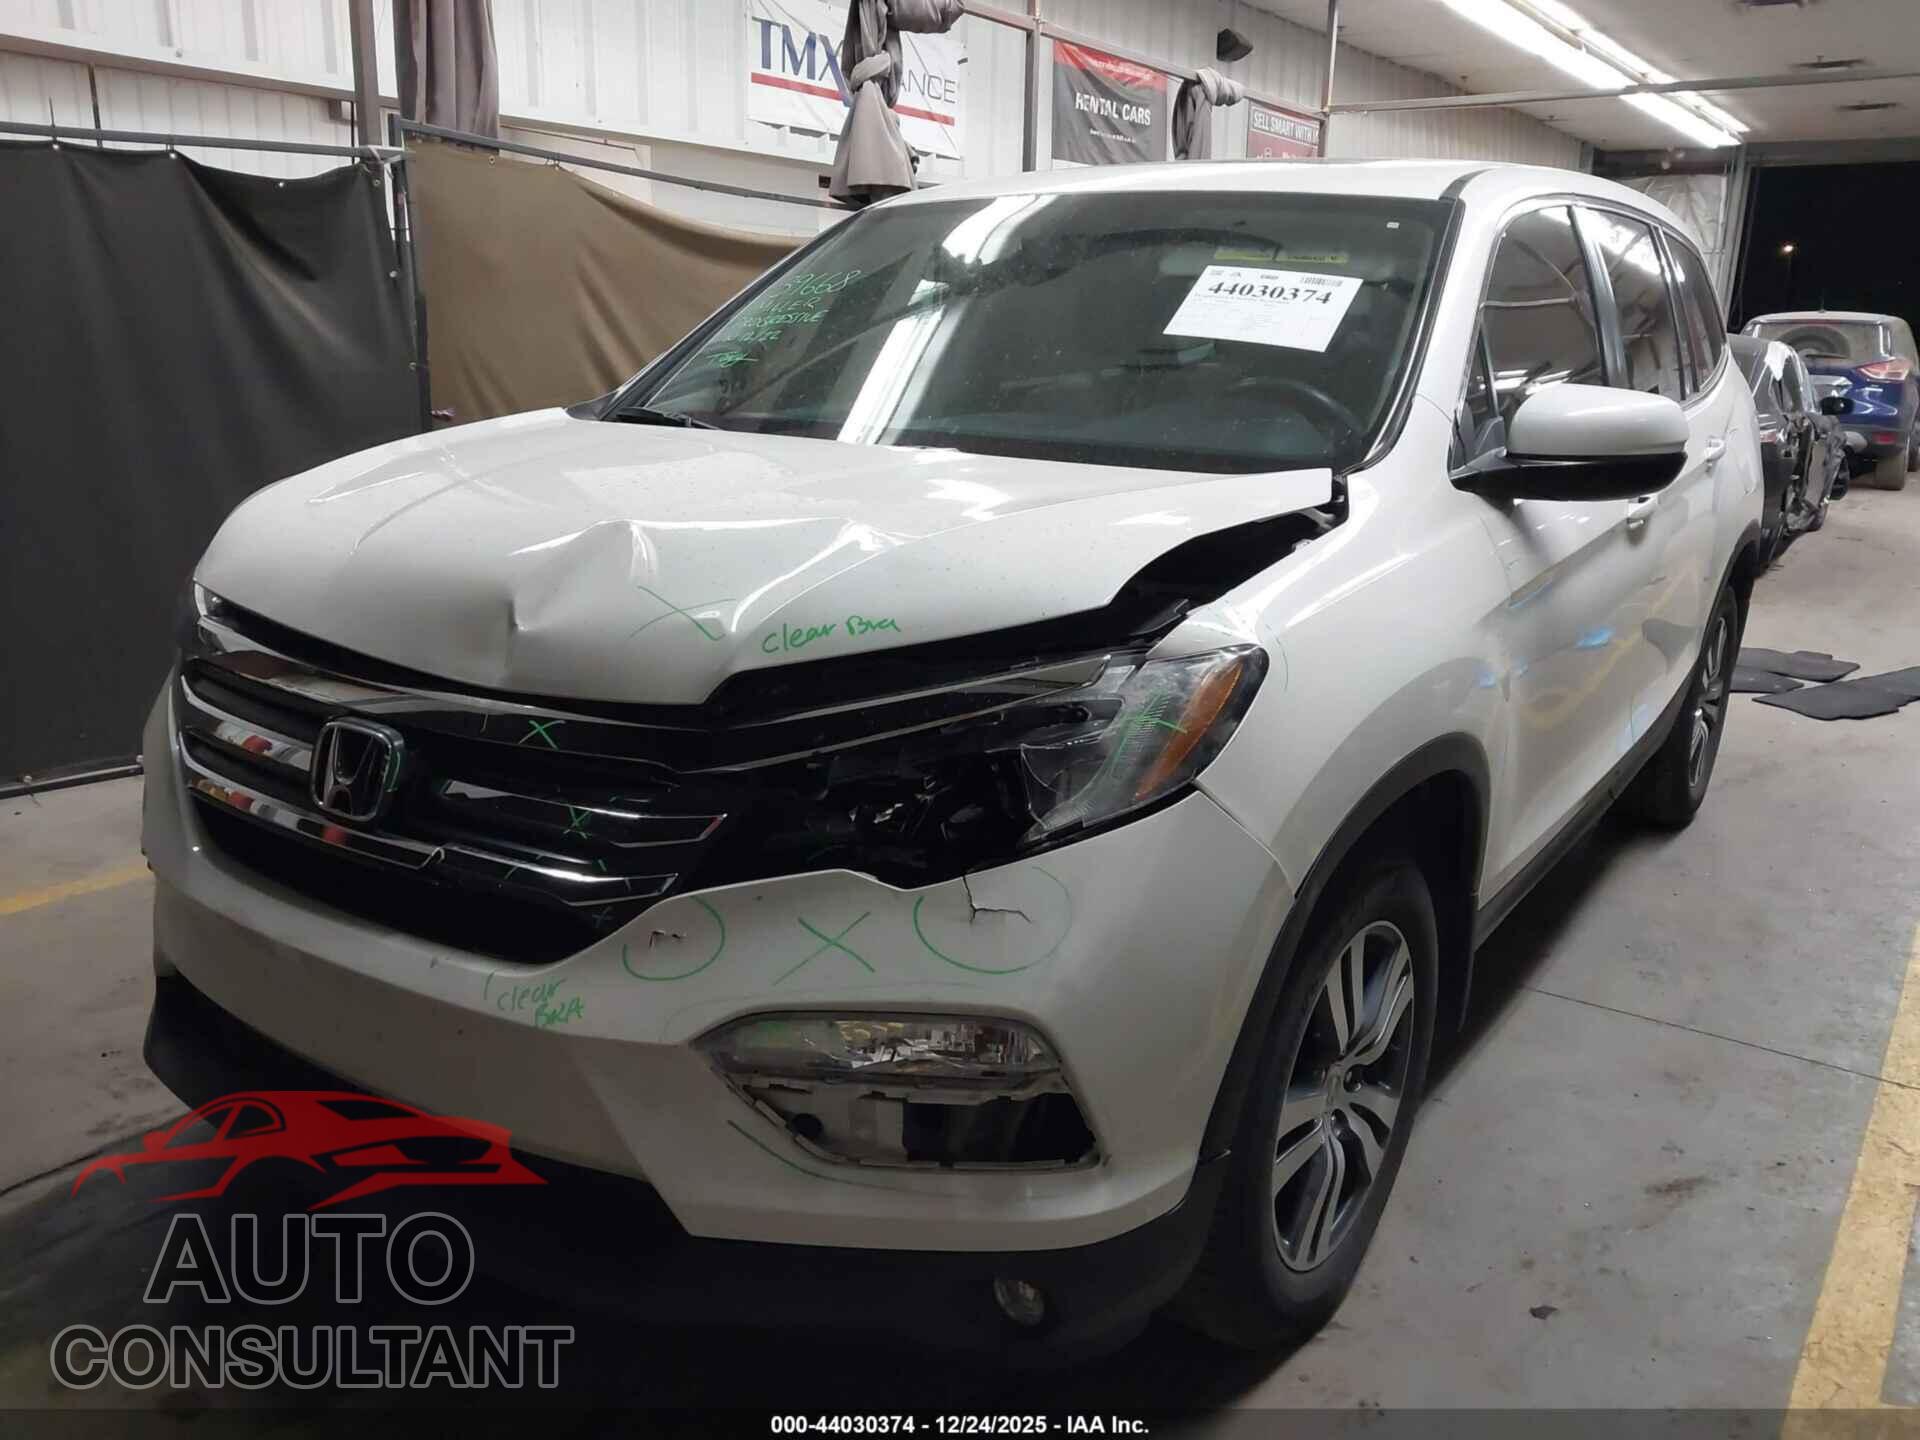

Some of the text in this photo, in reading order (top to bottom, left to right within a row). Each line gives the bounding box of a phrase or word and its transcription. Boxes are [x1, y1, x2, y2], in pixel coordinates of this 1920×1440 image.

[1075, 91, 1151, 126] RENTAL CARS
[1253, 110, 1269, 131] SELL
[1270, 116, 1295, 138] SMART
[1208, 281, 1333, 304] 44030374
